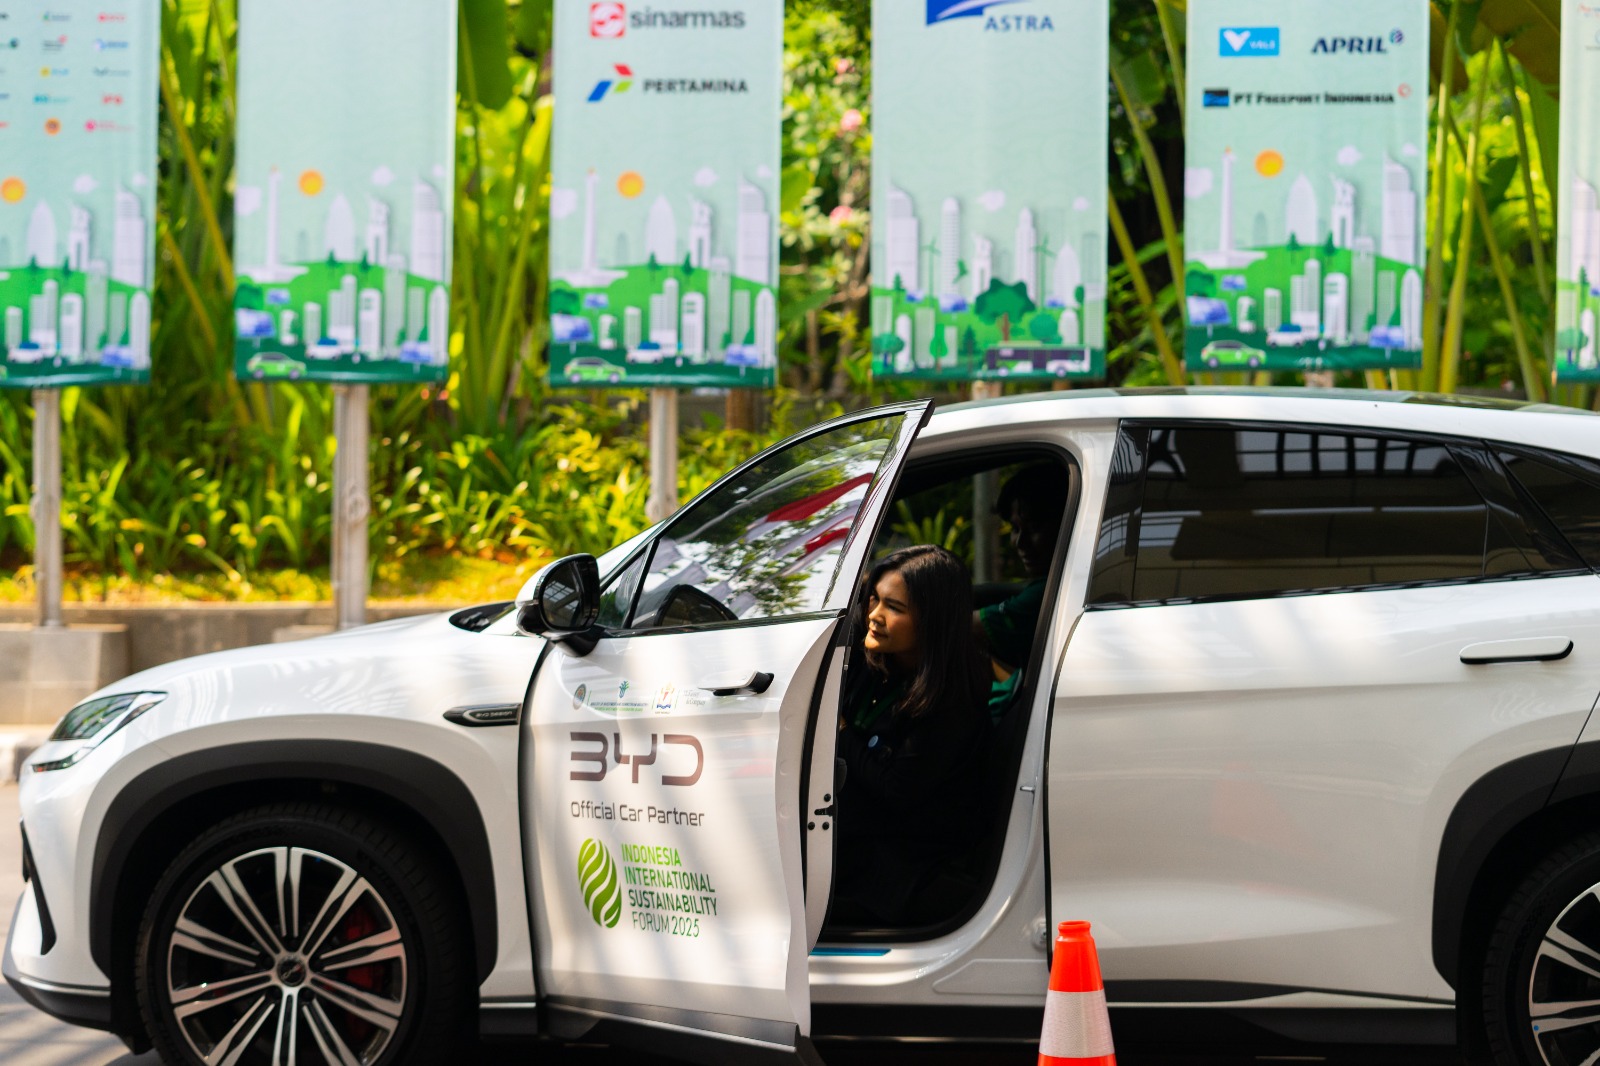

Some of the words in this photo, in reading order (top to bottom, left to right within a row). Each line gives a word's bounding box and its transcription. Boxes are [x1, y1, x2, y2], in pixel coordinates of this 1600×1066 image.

[630, 6, 746, 29] sinarmas
[984, 14, 1055, 32] ASTRA
[1311, 36, 1388, 54] APRIL
[643, 79, 749, 93] PERTAMINA
[1233, 93, 1252, 104] PT
[570, 731, 704, 787] BYD
[571, 800, 616, 821] Official
[619, 804, 644, 822] Car
[647, 805, 705, 827] Partner
[621, 843, 683, 867] INDONESIA
[624, 866, 716, 893] INTERNATIONAL
[628, 888, 718, 916] SUSTAINABILITY
[631, 911, 670, 934] FORUM
[671, 915, 700, 938] 2025
